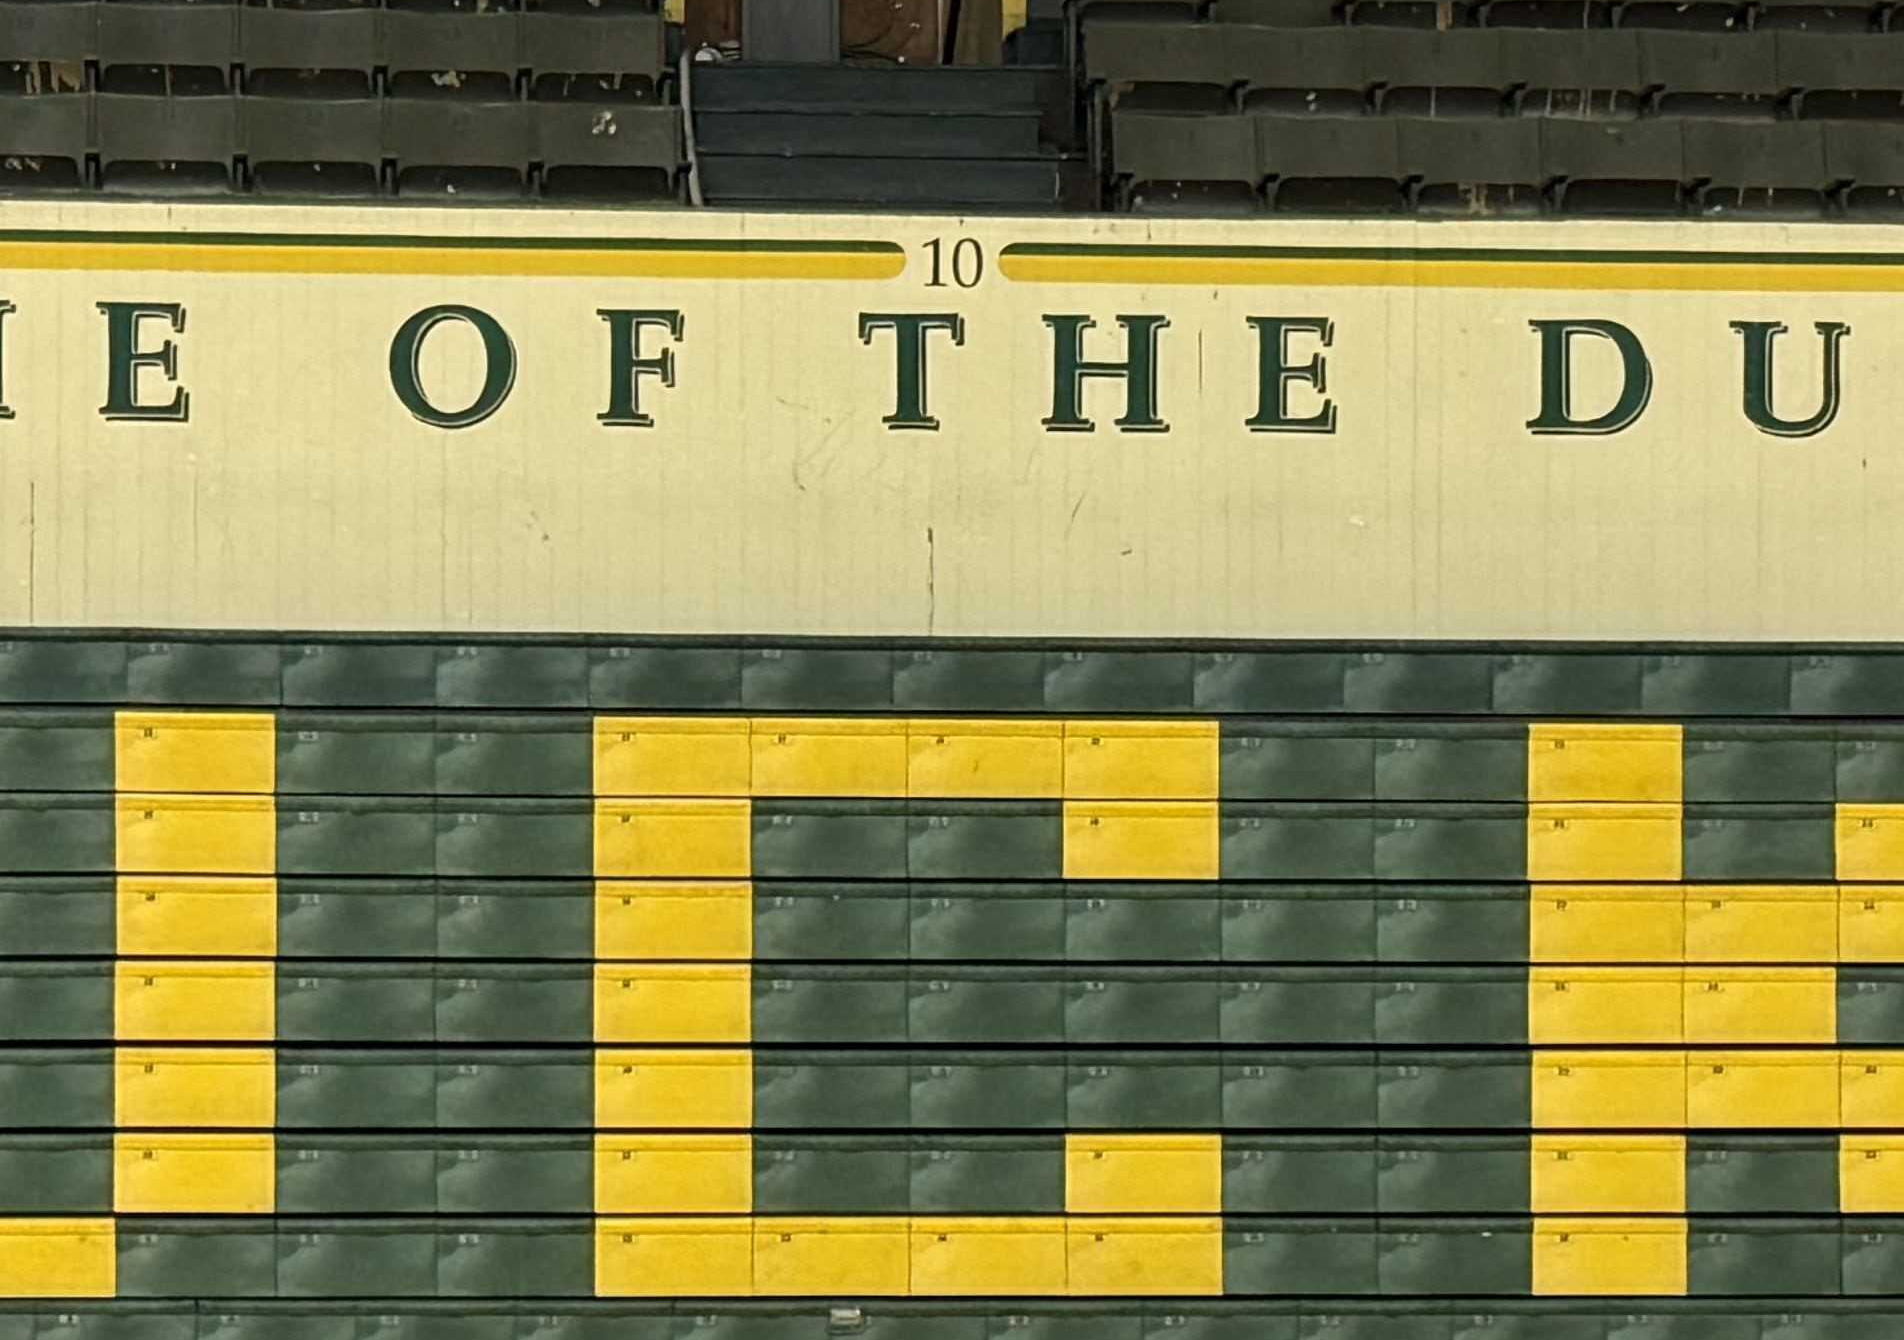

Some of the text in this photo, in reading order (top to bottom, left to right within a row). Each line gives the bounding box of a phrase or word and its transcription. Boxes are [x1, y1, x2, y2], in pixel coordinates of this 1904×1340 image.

[921, 237, 984, 289] 10
[389, 303, 686, 430] OF
[857, 311, 1339, 436] THE
